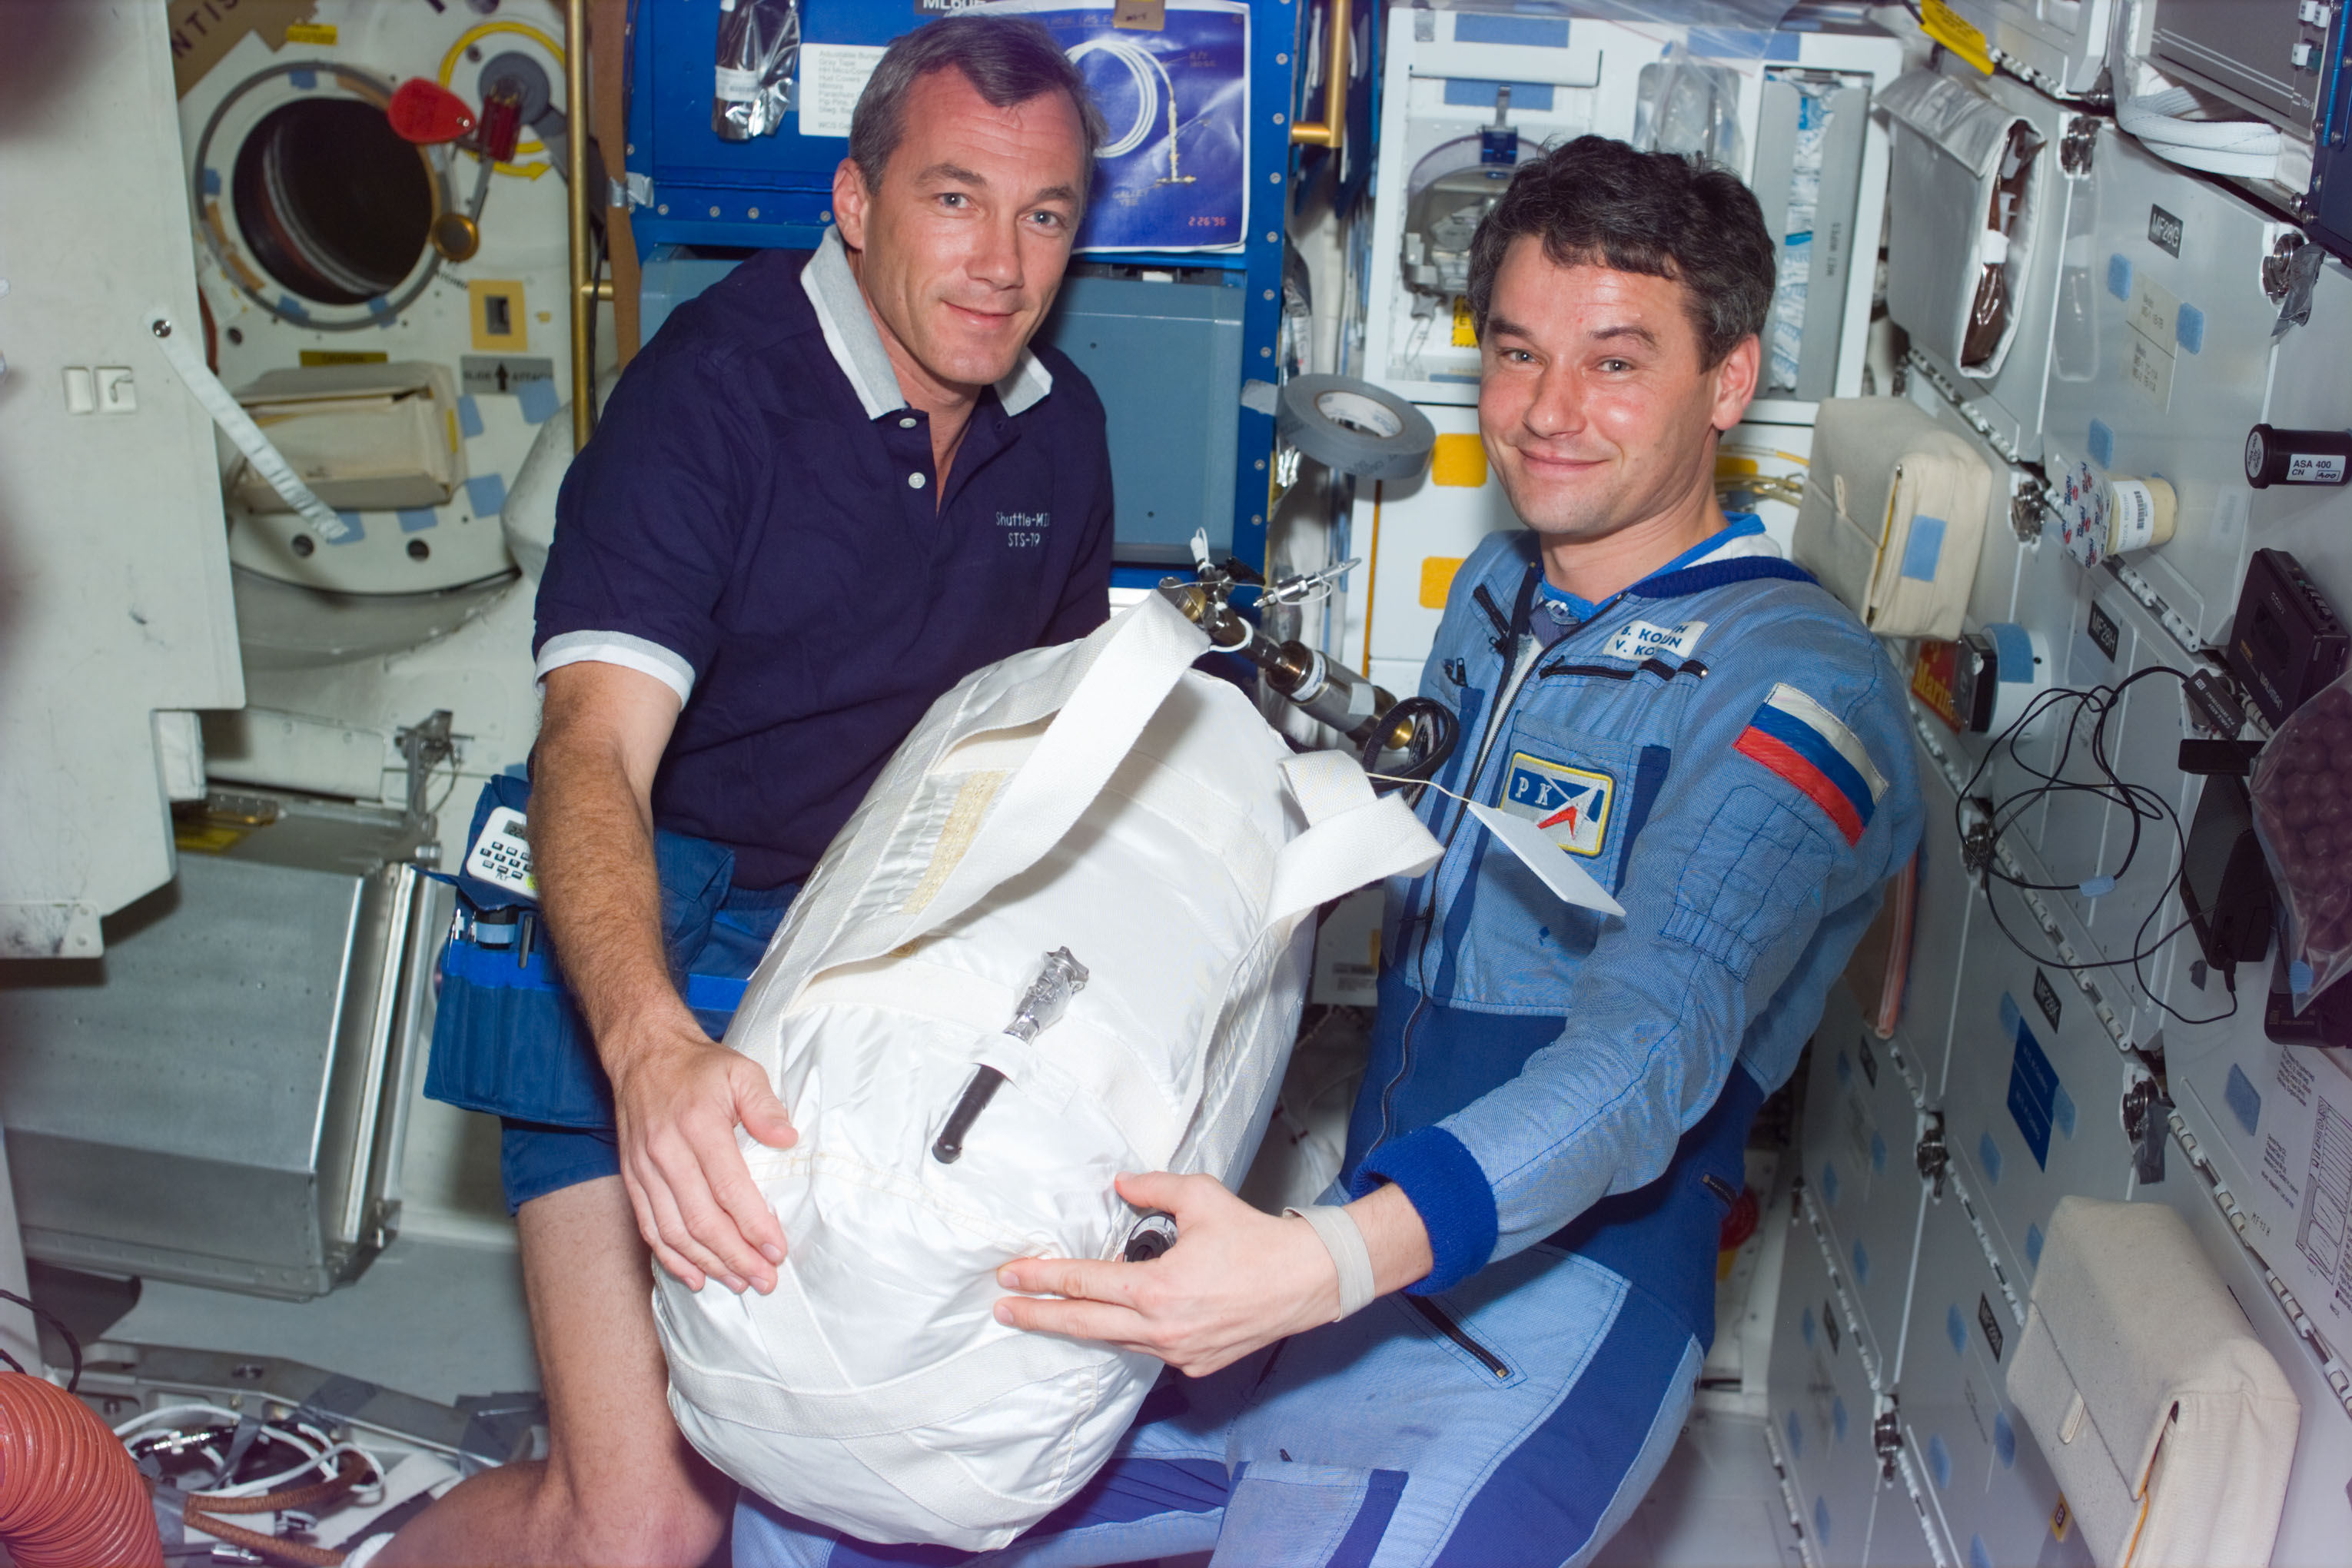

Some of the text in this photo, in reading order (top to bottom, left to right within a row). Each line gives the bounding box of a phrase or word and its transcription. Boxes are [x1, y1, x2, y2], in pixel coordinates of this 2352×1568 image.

[2293, 460, 2331, 469] ASA 400
[1008, 532, 1040, 548] STS-79
